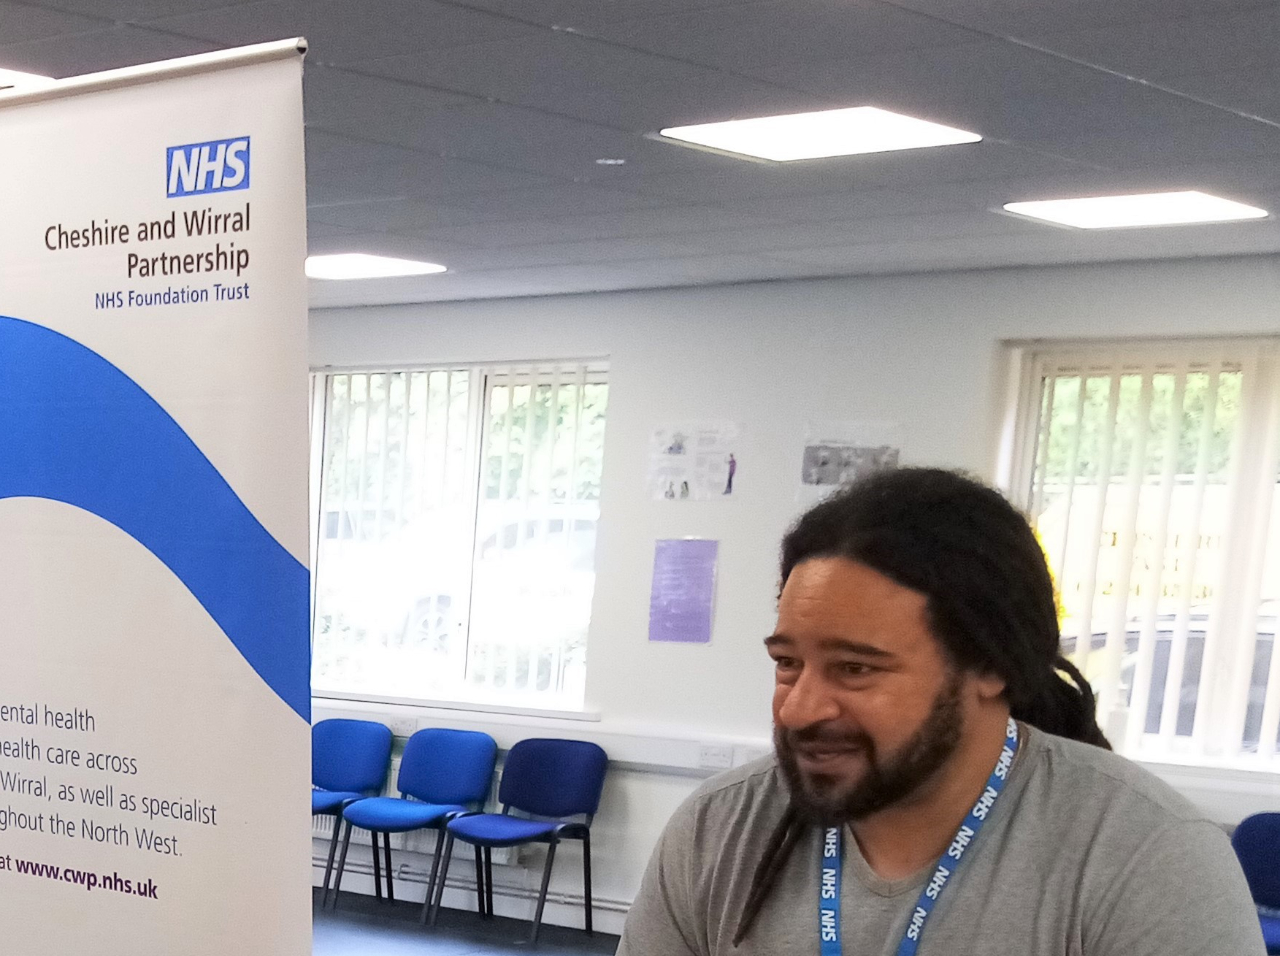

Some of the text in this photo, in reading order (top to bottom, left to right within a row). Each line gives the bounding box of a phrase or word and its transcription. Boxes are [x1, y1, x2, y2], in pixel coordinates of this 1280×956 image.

[168, 140, 249, 194] NHS
[45, 203, 250, 250] Cheshire and Wirral
[128, 242, 249, 278] Partnership
[95, 283, 249, 309] NHS Foundation Trust
[45, 706, 95, 732] health
[46, 746, 80, 766] care
[87, 752, 137, 775] across
[0, 770, 51, 801] Wirral,
[59, 784, 75, 801] as
[80, 786, 113, 808] well
[120, 793, 136, 811] as
[142, 795, 217, 826] specialist
[972, 786, 998, 821] NHS
[50, 813, 75, 837] the
[82, 818, 129, 846] North
[135, 827, 182, 856] West.
[948, 825, 974, 860] NHS
[16, 858, 158, 899] www.cwp.nhs.uk
[822, 868, 836, 899] NHS
[926, 866, 950, 900] NHS
[822, 909, 837, 941] NHS
[907, 907, 928, 941] NHS
